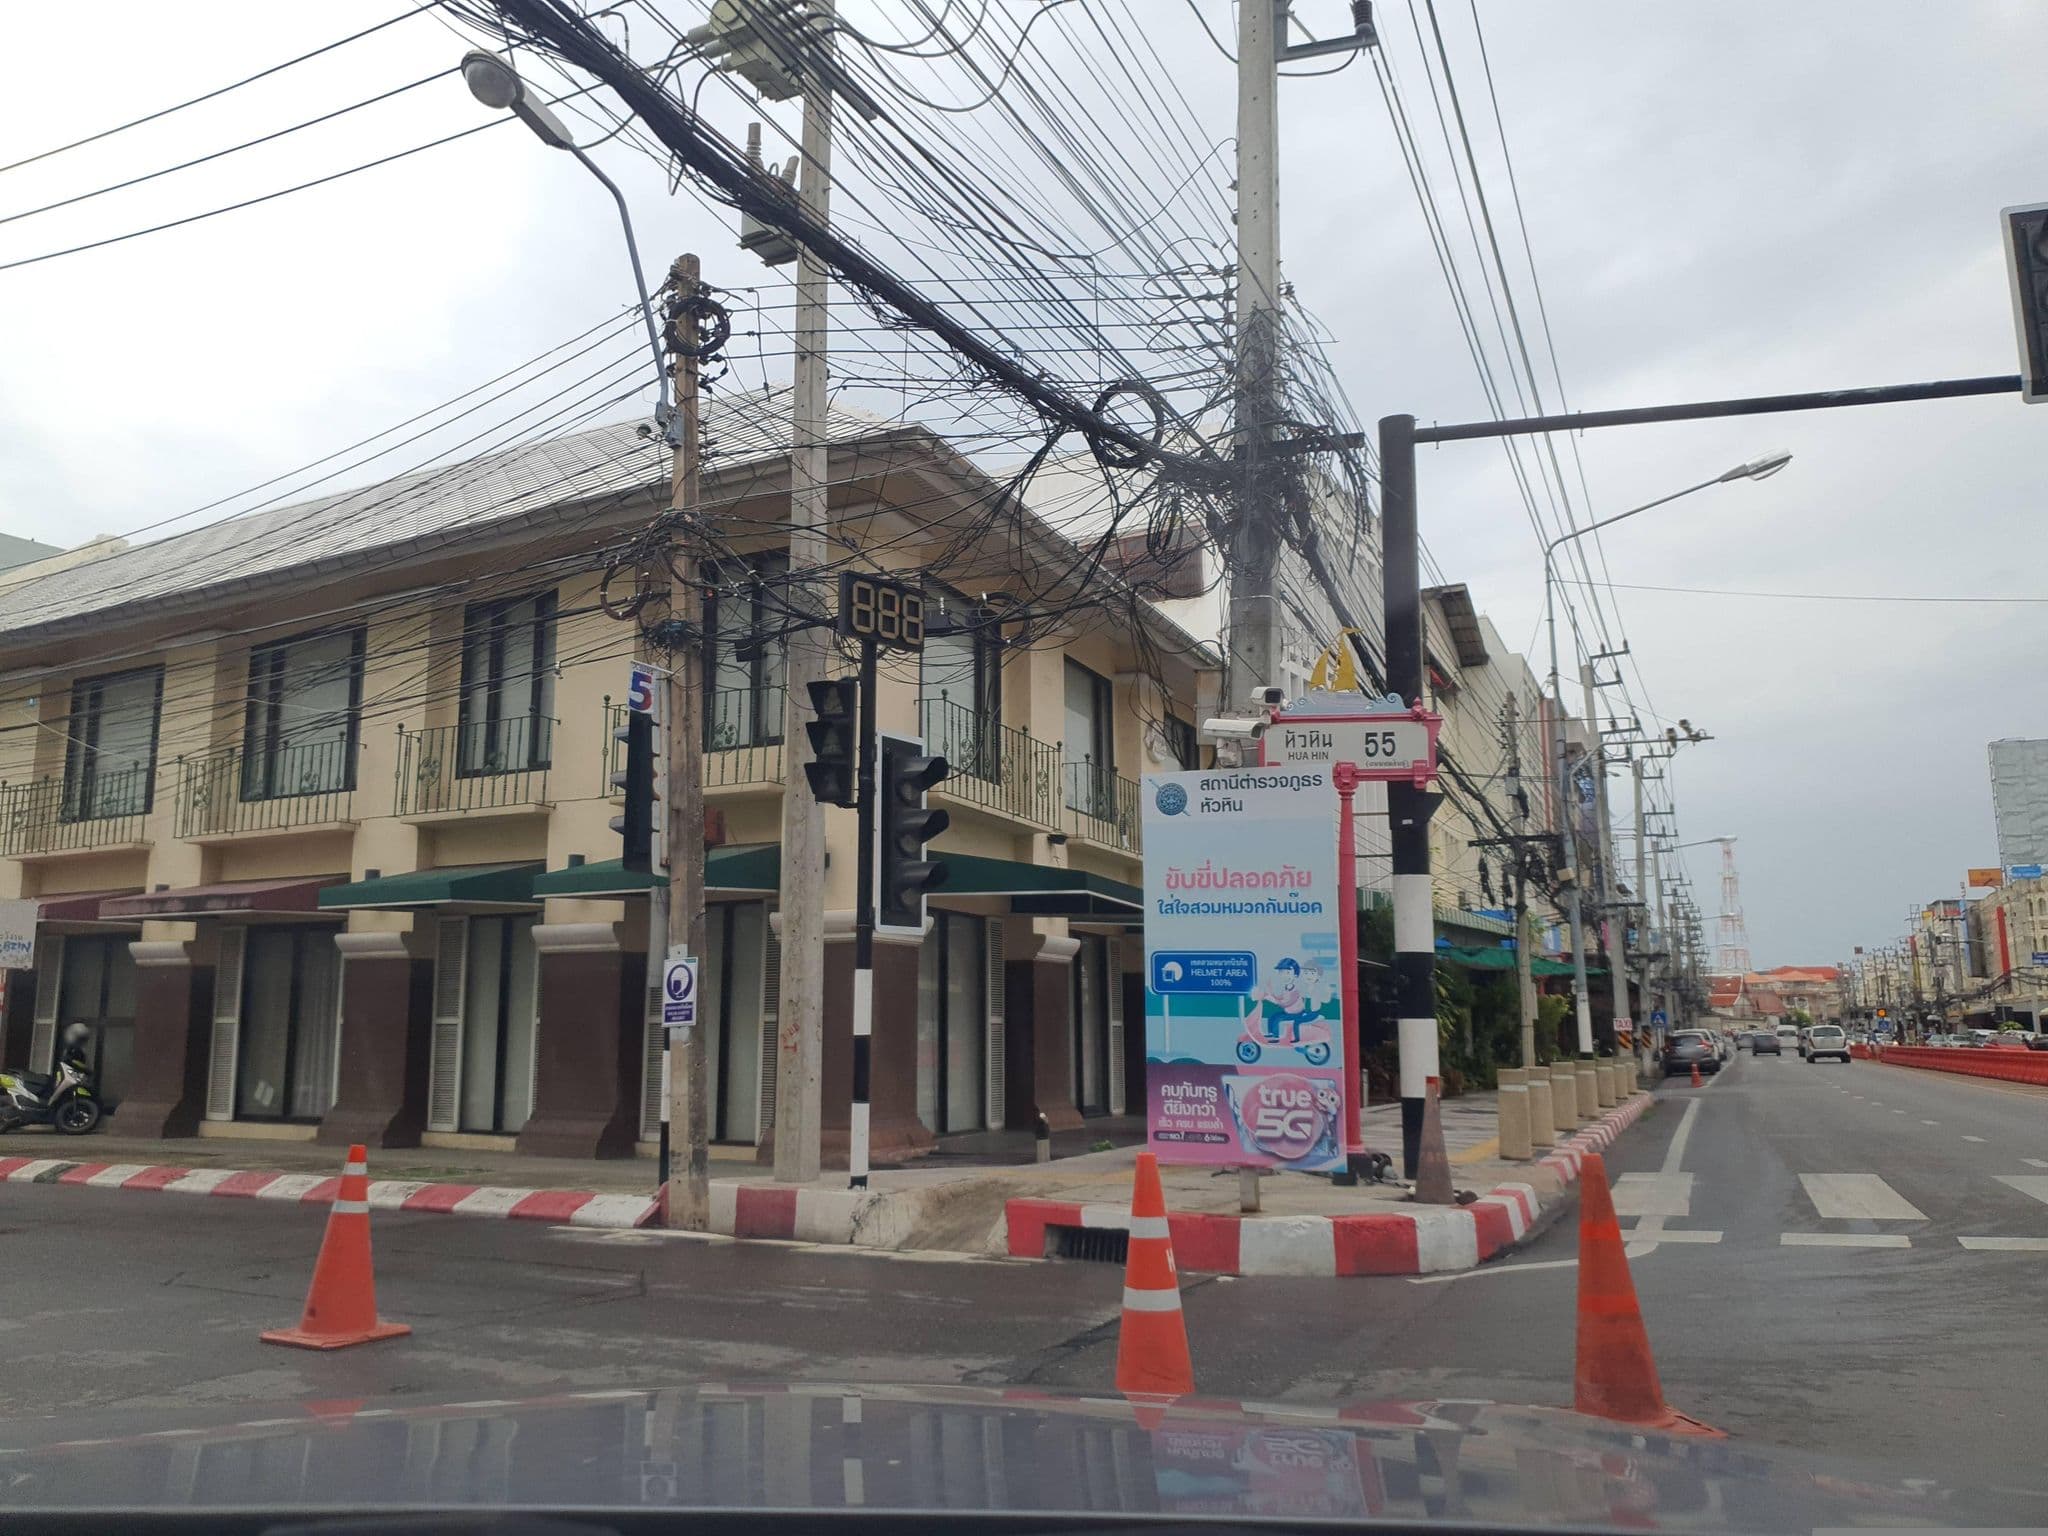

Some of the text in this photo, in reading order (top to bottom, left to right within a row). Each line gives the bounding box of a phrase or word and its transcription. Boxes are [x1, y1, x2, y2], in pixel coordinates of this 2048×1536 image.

[629, 670, 653, 711] 5
[1285, 729, 1396, 757] หัวหิน 55
[1287, 751, 1329, 761] HUA HIN
[1200, 773, 1323, 792] สถานีตำรวจภูธร
[1200, 796, 1243, 813] หัวหิน
[1165, 859, 1312, 890] ขับขี่ปลอดภัย
[1190, 968, 1249, 977] HELMET AREA
[1210, 978, 1233, 987] 100%
[1258, 1085, 1312, 1109] true
[1255, 1108, 1313, 1139] 5G
